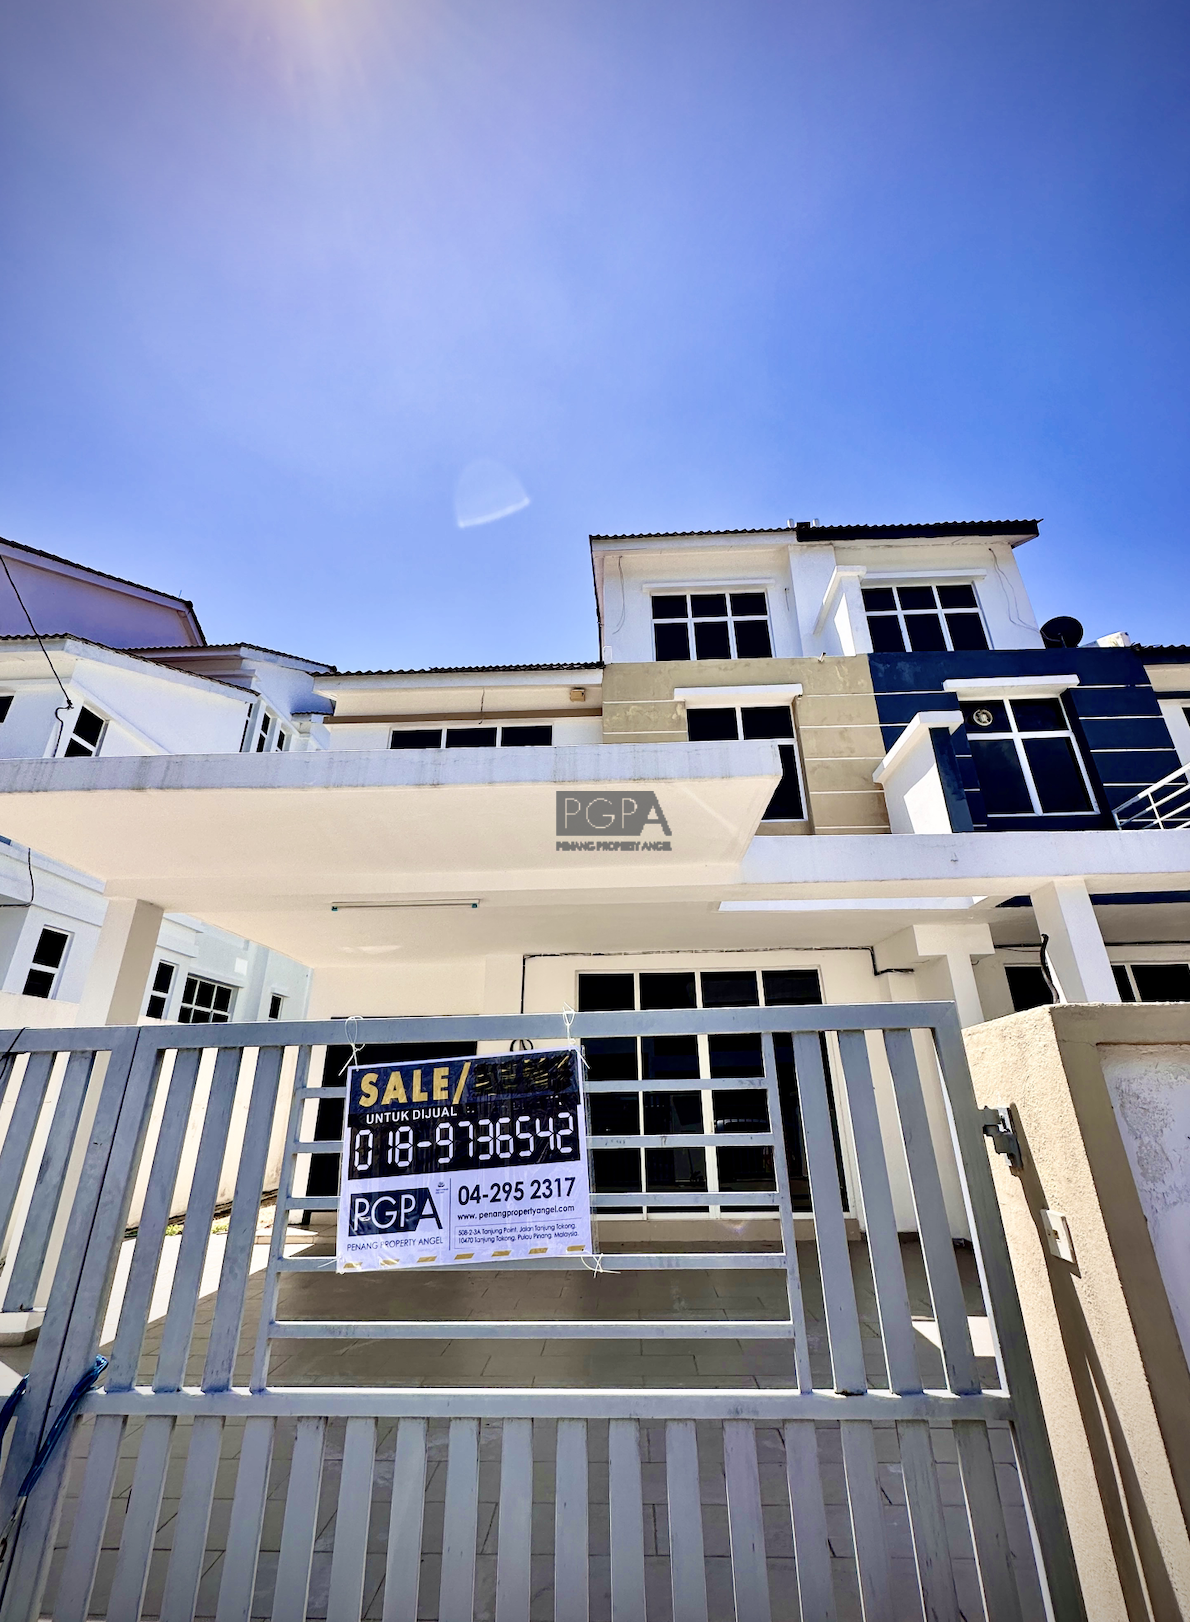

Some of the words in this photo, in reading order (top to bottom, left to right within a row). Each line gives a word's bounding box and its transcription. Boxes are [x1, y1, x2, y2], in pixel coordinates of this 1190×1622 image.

[366, 1110, 410, 1124] UNTUK
[413, 1106, 457, 1120] DIJUAL
[458, 1181, 524, 1205] 04-295
[530, 1177, 575, 1199] 2317
[352, 1188, 443, 1233] PGPA
[347, 1242, 378, 1251] PENANG
[380, 1239, 416, 1249] PROPERTY
[418, 1236, 443, 1245] ANGEL
